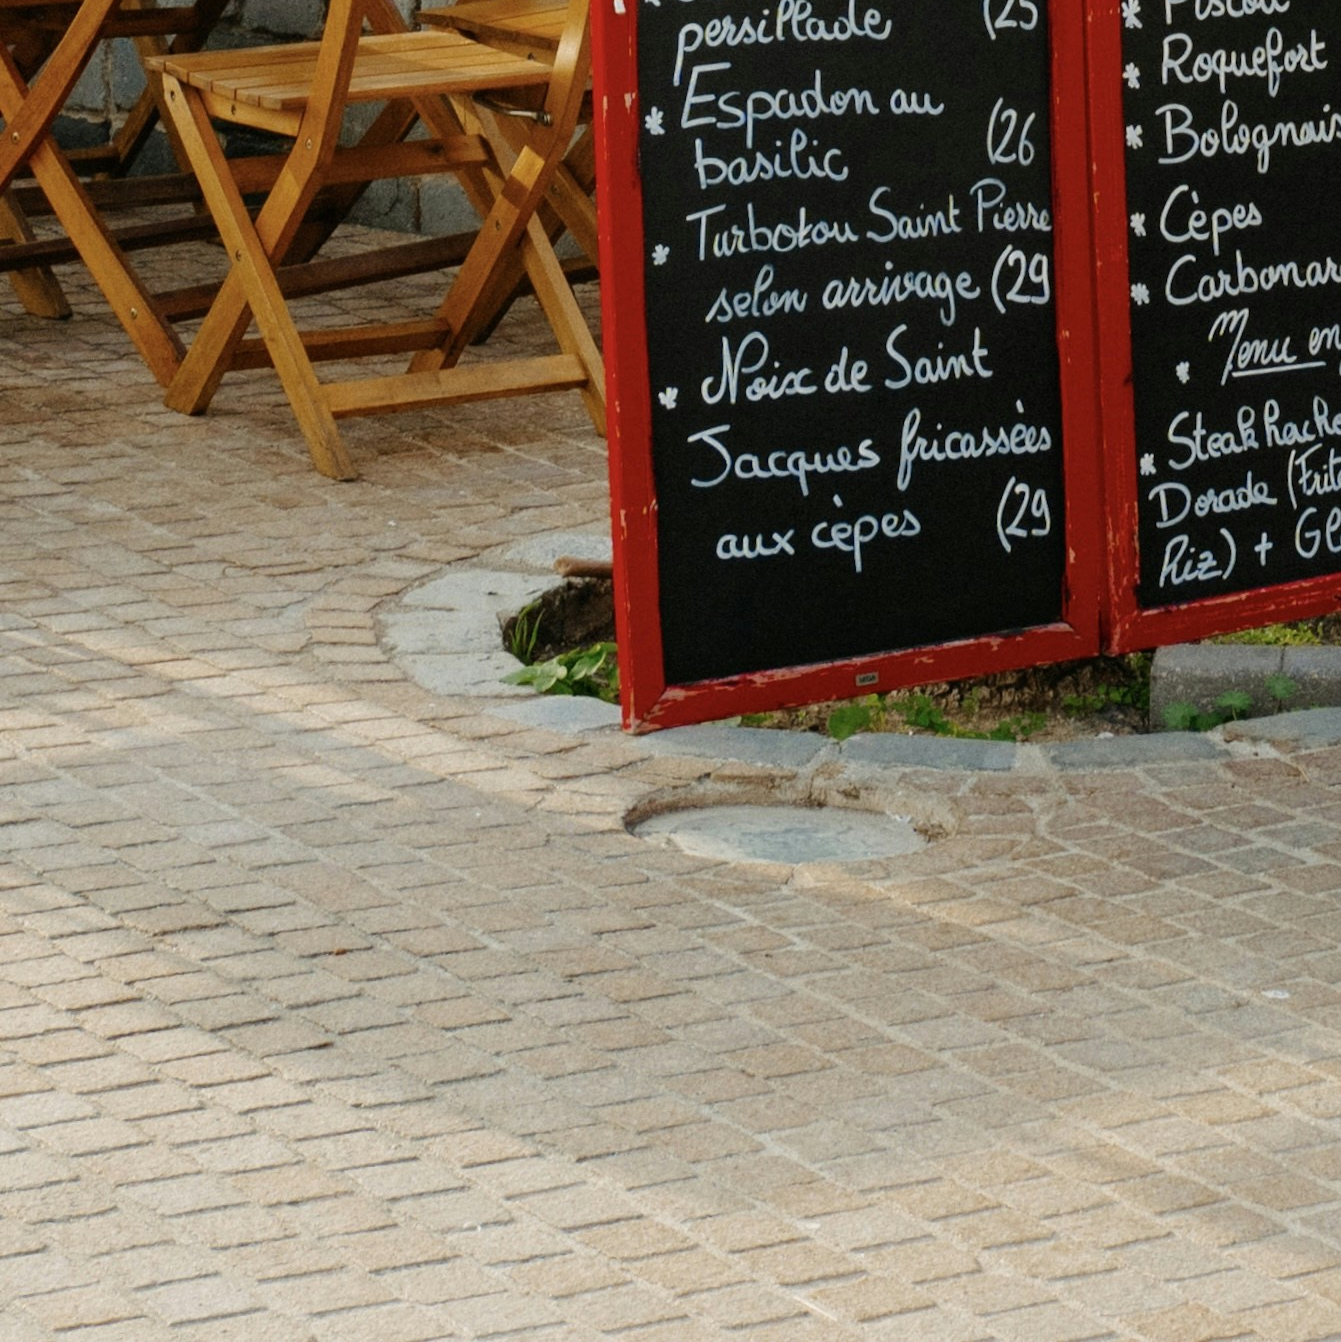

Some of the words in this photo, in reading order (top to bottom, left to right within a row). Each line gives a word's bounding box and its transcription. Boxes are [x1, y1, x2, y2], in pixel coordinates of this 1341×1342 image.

[1161, 26, 1328, 98] Roquefort
[680, 62, 880, 149] Espadon
[889, 88, 945, 116] au
[694, 128, 849, 190] basilic
[866, 186, 963, 244] Saint
[970, 178, 1052, 235] Pierre
[1158, 184, 1263, 257] Cèpes
[704, 264, 808, 324] selon
[822, 261, 981, 326] arrivage
[701, 331, 817, 405] Noix
[824, 346, 873, 394] de
[884, 323, 994, 391] Saint
[1208, 307, 1298, 386] Menu
[687, 424, 881, 497] Jacques
[896, 399, 1052, 491] fricassées
[1168, 405, 1259, 471] Steak
[716, 528, 796, 561] aux
[811, 494, 922, 574] cèpes
[1148, 471, 1278, 529] Dorade
[1158, 527, 1237, 588] Riz)
